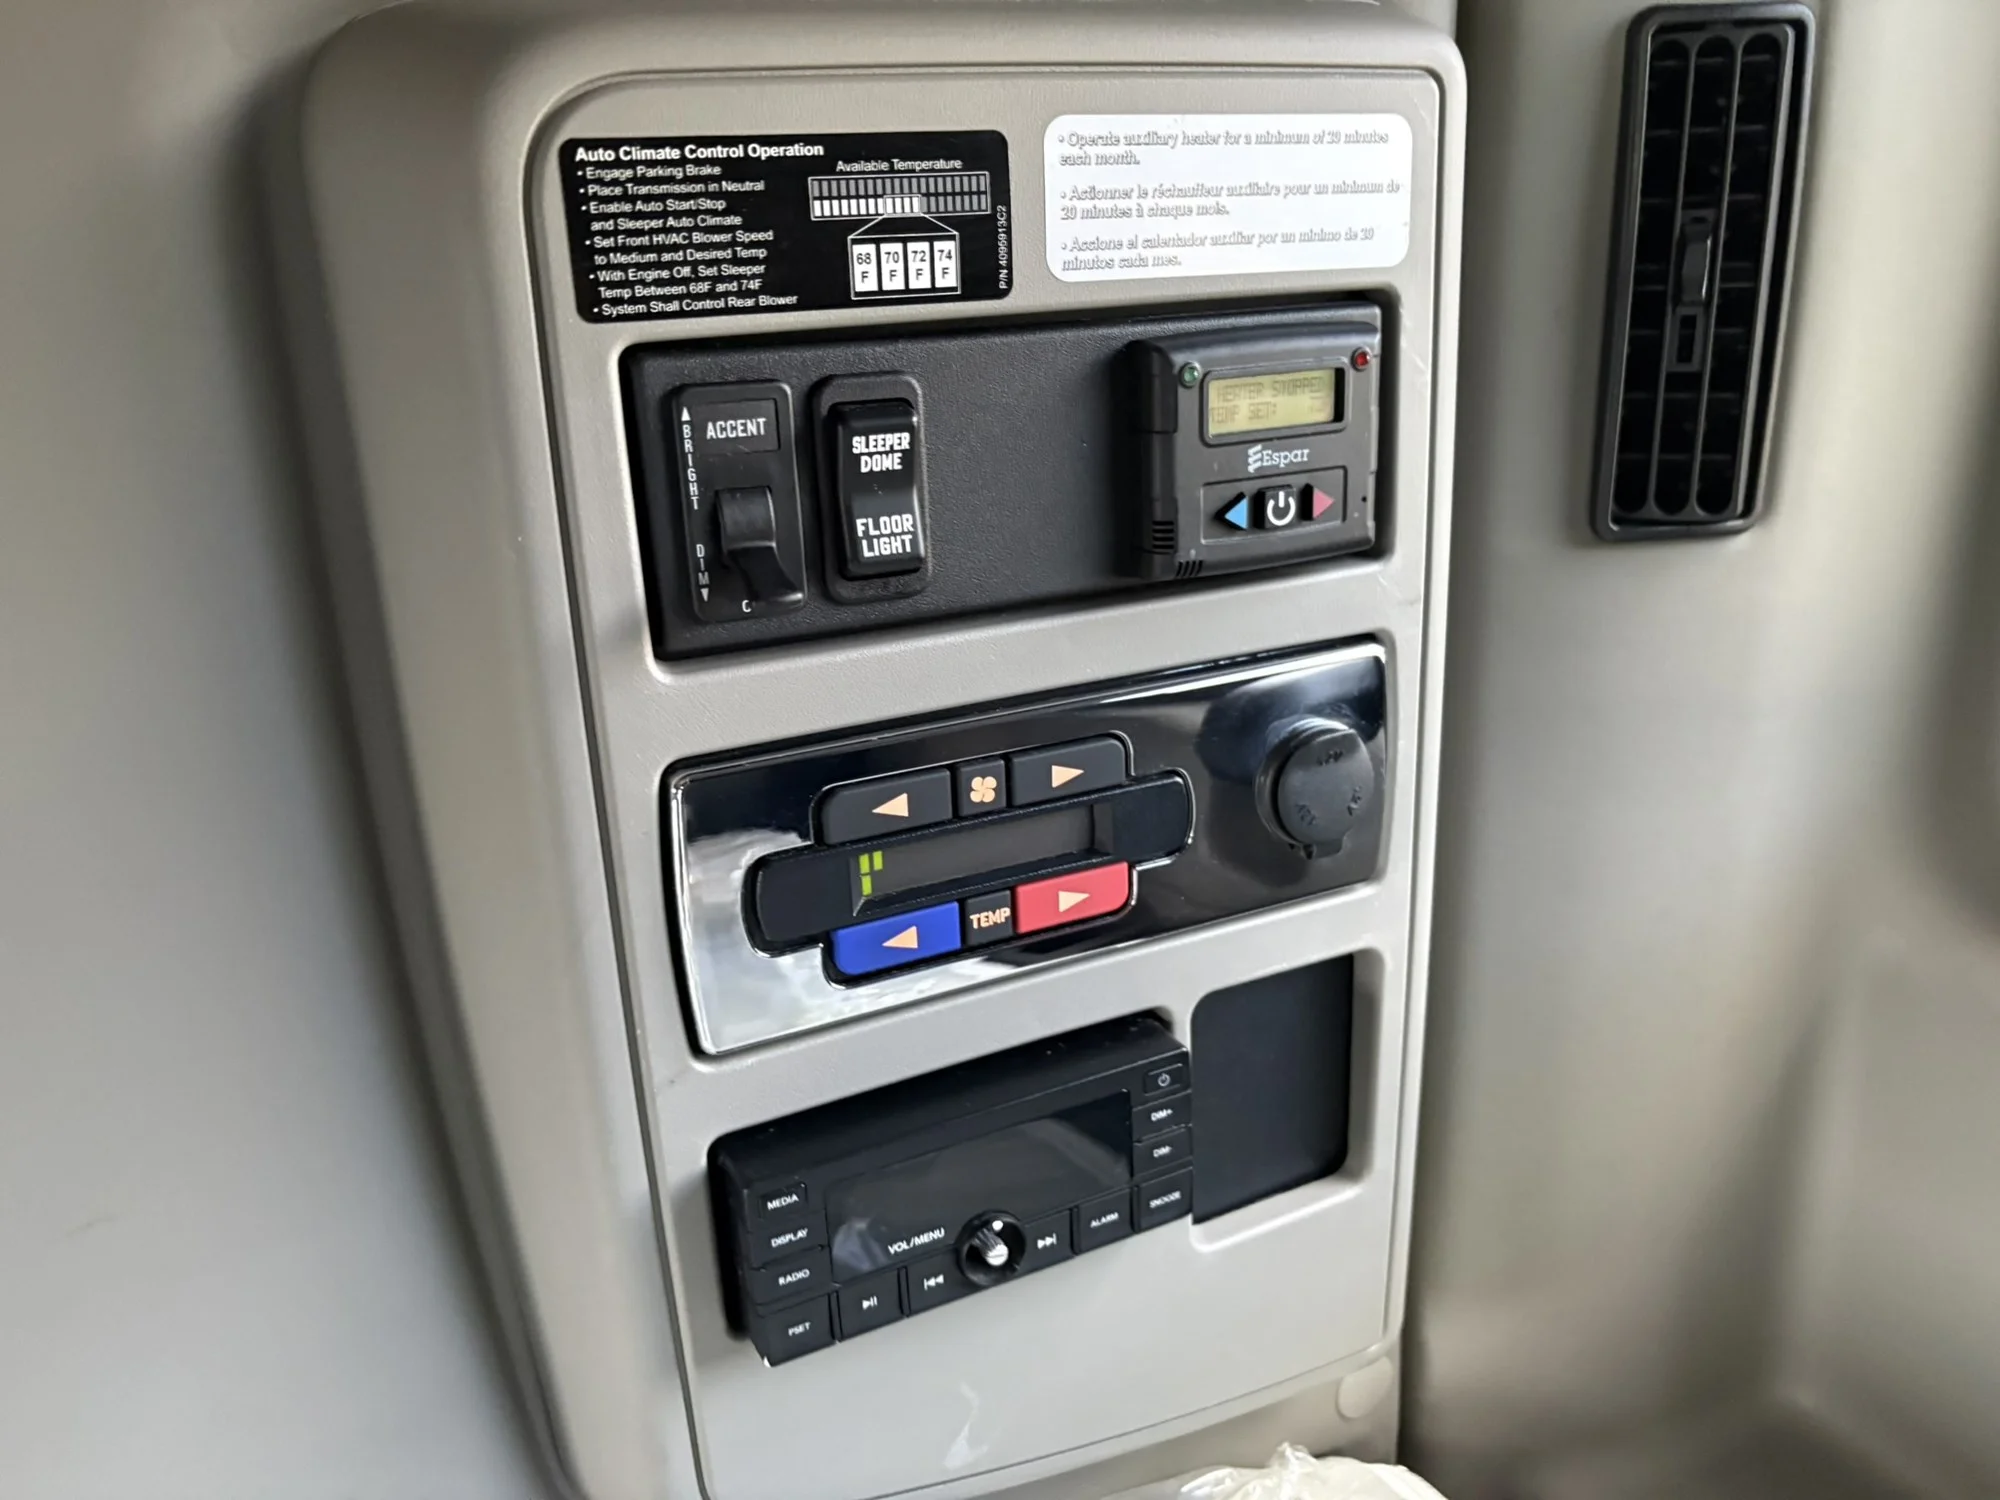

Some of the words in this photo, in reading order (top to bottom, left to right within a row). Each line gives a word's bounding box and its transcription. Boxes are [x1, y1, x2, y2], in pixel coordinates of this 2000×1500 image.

[1067, 132, 1120, 150] Operate
[1123, 131, 1178, 149] auxiliary
[1181, 131, 1221, 146] heater
[1223, 131, 1241, 146] for
[1244, 133, 1252, 145] a
[1254, 131, 1310, 145] minimum
[1312, 130, 1325, 145] of
[1344, 130, 1389, 144] minutes
[575, 147, 615, 162] Auto
[619, 145, 681, 161] Climate
[684, 144, 744, 159] Control
[748, 142, 824, 160] Operation
[1059, 152, 1091, 166] each
[1095, 150, 1140, 166] month.
[586, 166, 634, 180] Engage
[636, 165, 684, 179] Parking
[685, 164, 722, 176] Brake
[836, 160, 889, 172] Available
[891, 158, 962, 172] Temperature
[587, 184, 623, 196] Place
[625, 182, 705, 195] Transmission
[707, 181, 719, 192] in
[721, 180, 765, 192] Neutral
[1069, 186, 1134, 201] Actionner
[1137, 184, 1148, 198] le
[1151, 183, 1223, 198] réchauffeur
[1226, 182, 1281, 197] auxiliaire
[1283, 184, 1311, 199] pour
[1313, 183, 1329, 195] un
[1331, 181, 1384, 194] minimum
[1386, 180, 1400, 193] de
[590, 202, 632, 214] Enable
[635, 200, 664, 212] Auto
[666, 198, 727, 211] Start/Stop
[1080, 205, 1132, 219] minutes
[1147, 203, 1193, 220] chaque
[1196, 202, 1230, 216] mois.
[590, 220, 614, 231] and
[617, 217, 664, 232] Sleeper
[666, 216, 695, 228] Auto
[696, 215, 743, 227] Climate
[593, 236, 614, 248] Set
[618, 235, 650, 247] Front
[652, 233, 689, 245] HVAC
[692, 231, 733, 244] Blower
[735, 230, 774, 243] Speed
[1069, 237, 1123, 252] Accione
[1126, 235, 1139, 249] el
[1141, 233, 1208, 249] calentador
[1209, 231, 1255, 246] auxiliar
[1257, 233, 1278, 248] por
[1280, 232, 1296, 243] un
[1344, 228, 1358, 241] de
[594, 254, 607, 265] to
[609, 252, 658, 264] Medium
[660, 250, 684, 262] and
[686, 248, 732, 261] Desired
[734, 247, 767, 261] Temp
[856, 253, 872, 265] 68
[884, 251, 900, 263] 70
[911, 251, 927, 263] 72
[937, 249, 953, 261] 74
[1061, 256, 1114, 271] minutos
[1117, 254, 1148, 269] cada
[1151, 254, 1182, 267] mes.
[597, 269, 625, 281] With
[628, 267, 670, 282] Engine
[697, 266, 718, 277] Set
[720, 264, 766, 278] Sleeper
[861, 271, 869, 283] F
[889, 270, 898, 281] F
[915, 269, 924, 281] F
[941, 267, 950, 279] F
[999, 269, 1009, 289] P/N
[598, 287, 632, 300] Temp
[634, 284, 687, 297] Between
[689, 282, 712, 294] 68F
[715, 280, 738, 292] and
[740, 279, 763, 291] 74F
[601, 303, 647, 317] System
[650, 300, 680, 312] Shall
[682, 298, 725, 311] Control
[727, 296, 755, 308] Rear
[758, 295, 798, 307] Blower
[706, 417, 767, 440] ACCENT
[852, 432, 911, 454] SLEEPER
[682, 424, 700, 510] BRIGHT
[860, 452, 903, 473] DOME
[1261, 448, 1310, 468] Espar
[856, 513, 914, 537] FLOOR
[862, 534, 913, 558] LIGHT
[696, 544, 710, 585] DIM
[969, 907, 1011, 929] TEMP
[1151, 1108, 1173, 1121] DIM+
[767, 1193, 799, 1211] MEDIA
[1149, 1190, 1181, 1208] SNOOZE
[1090, 1212, 1119, 1228] ALARM
[771, 1228, 808, 1248] DISPLAY
[888, 1227, 945, 1255] VOL/MENU
[778, 1268, 810, 1286] RADIO
[788, 1322, 811, 1336] PSET
